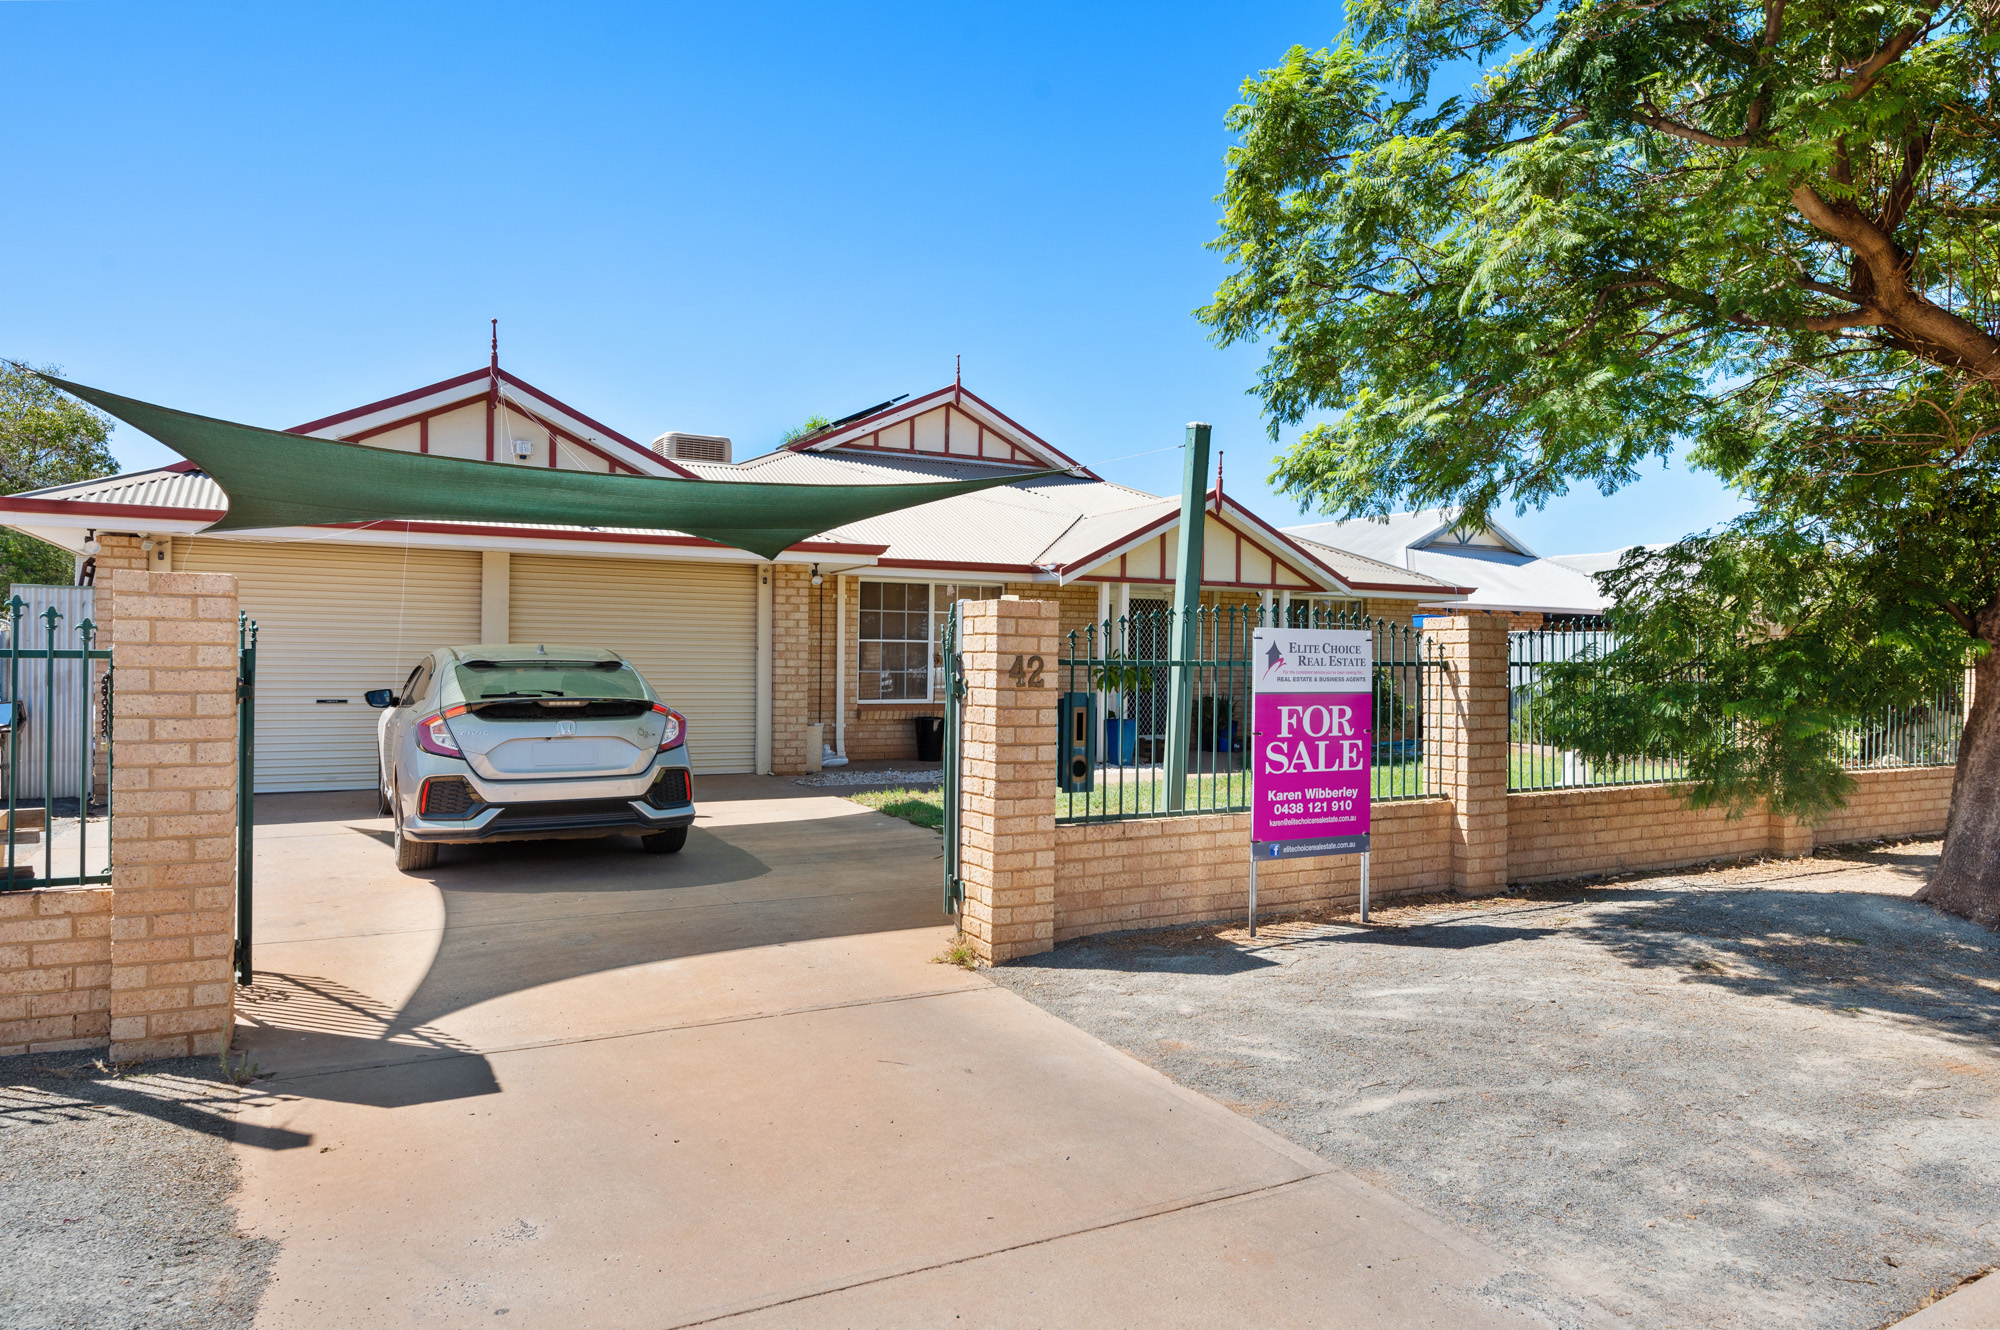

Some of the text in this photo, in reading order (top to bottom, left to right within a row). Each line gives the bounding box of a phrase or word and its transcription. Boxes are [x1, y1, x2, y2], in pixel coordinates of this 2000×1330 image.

[1289, 642, 1361, 654] ELITE CHOICE
[1298, 655, 1366, 667] REAL ESTATE
[1009, 655, 1044, 687] 42
[1277, 705, 1354, 737] FOR
[1265, 740, 1363, 774] SALE
[1268, 787, 1358, 801] Karen Wibberley
[1274, 800, 1352, 815] 0438 121 910
[1269, 815, 1356, 827] karen@elitechoicerealestate.com.au
[1283, 842, 1356, 853] elitechoicerealestate.com.au
